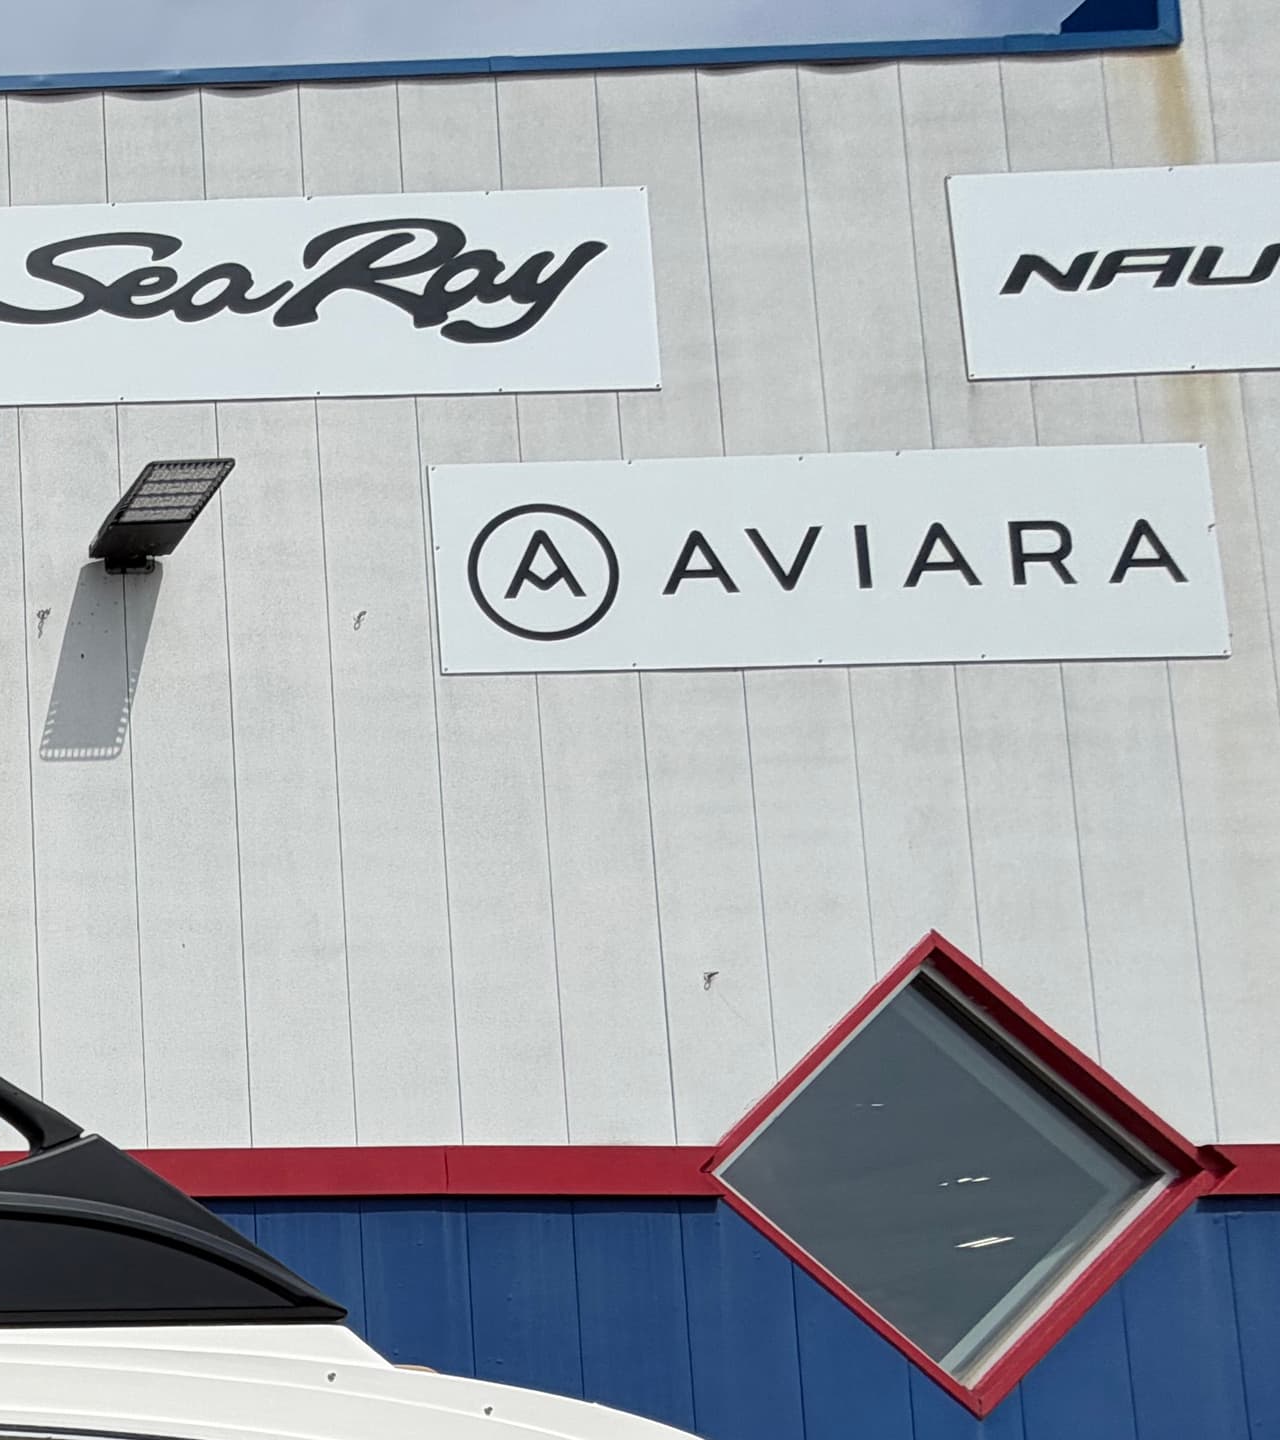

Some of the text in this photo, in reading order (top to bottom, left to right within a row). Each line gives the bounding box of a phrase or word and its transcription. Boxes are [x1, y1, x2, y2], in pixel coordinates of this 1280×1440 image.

[273, 218, 608, 344] Ray
[999, 242, 1280, 295] NAU
[662, 518, 1188, 595] AVIARA
